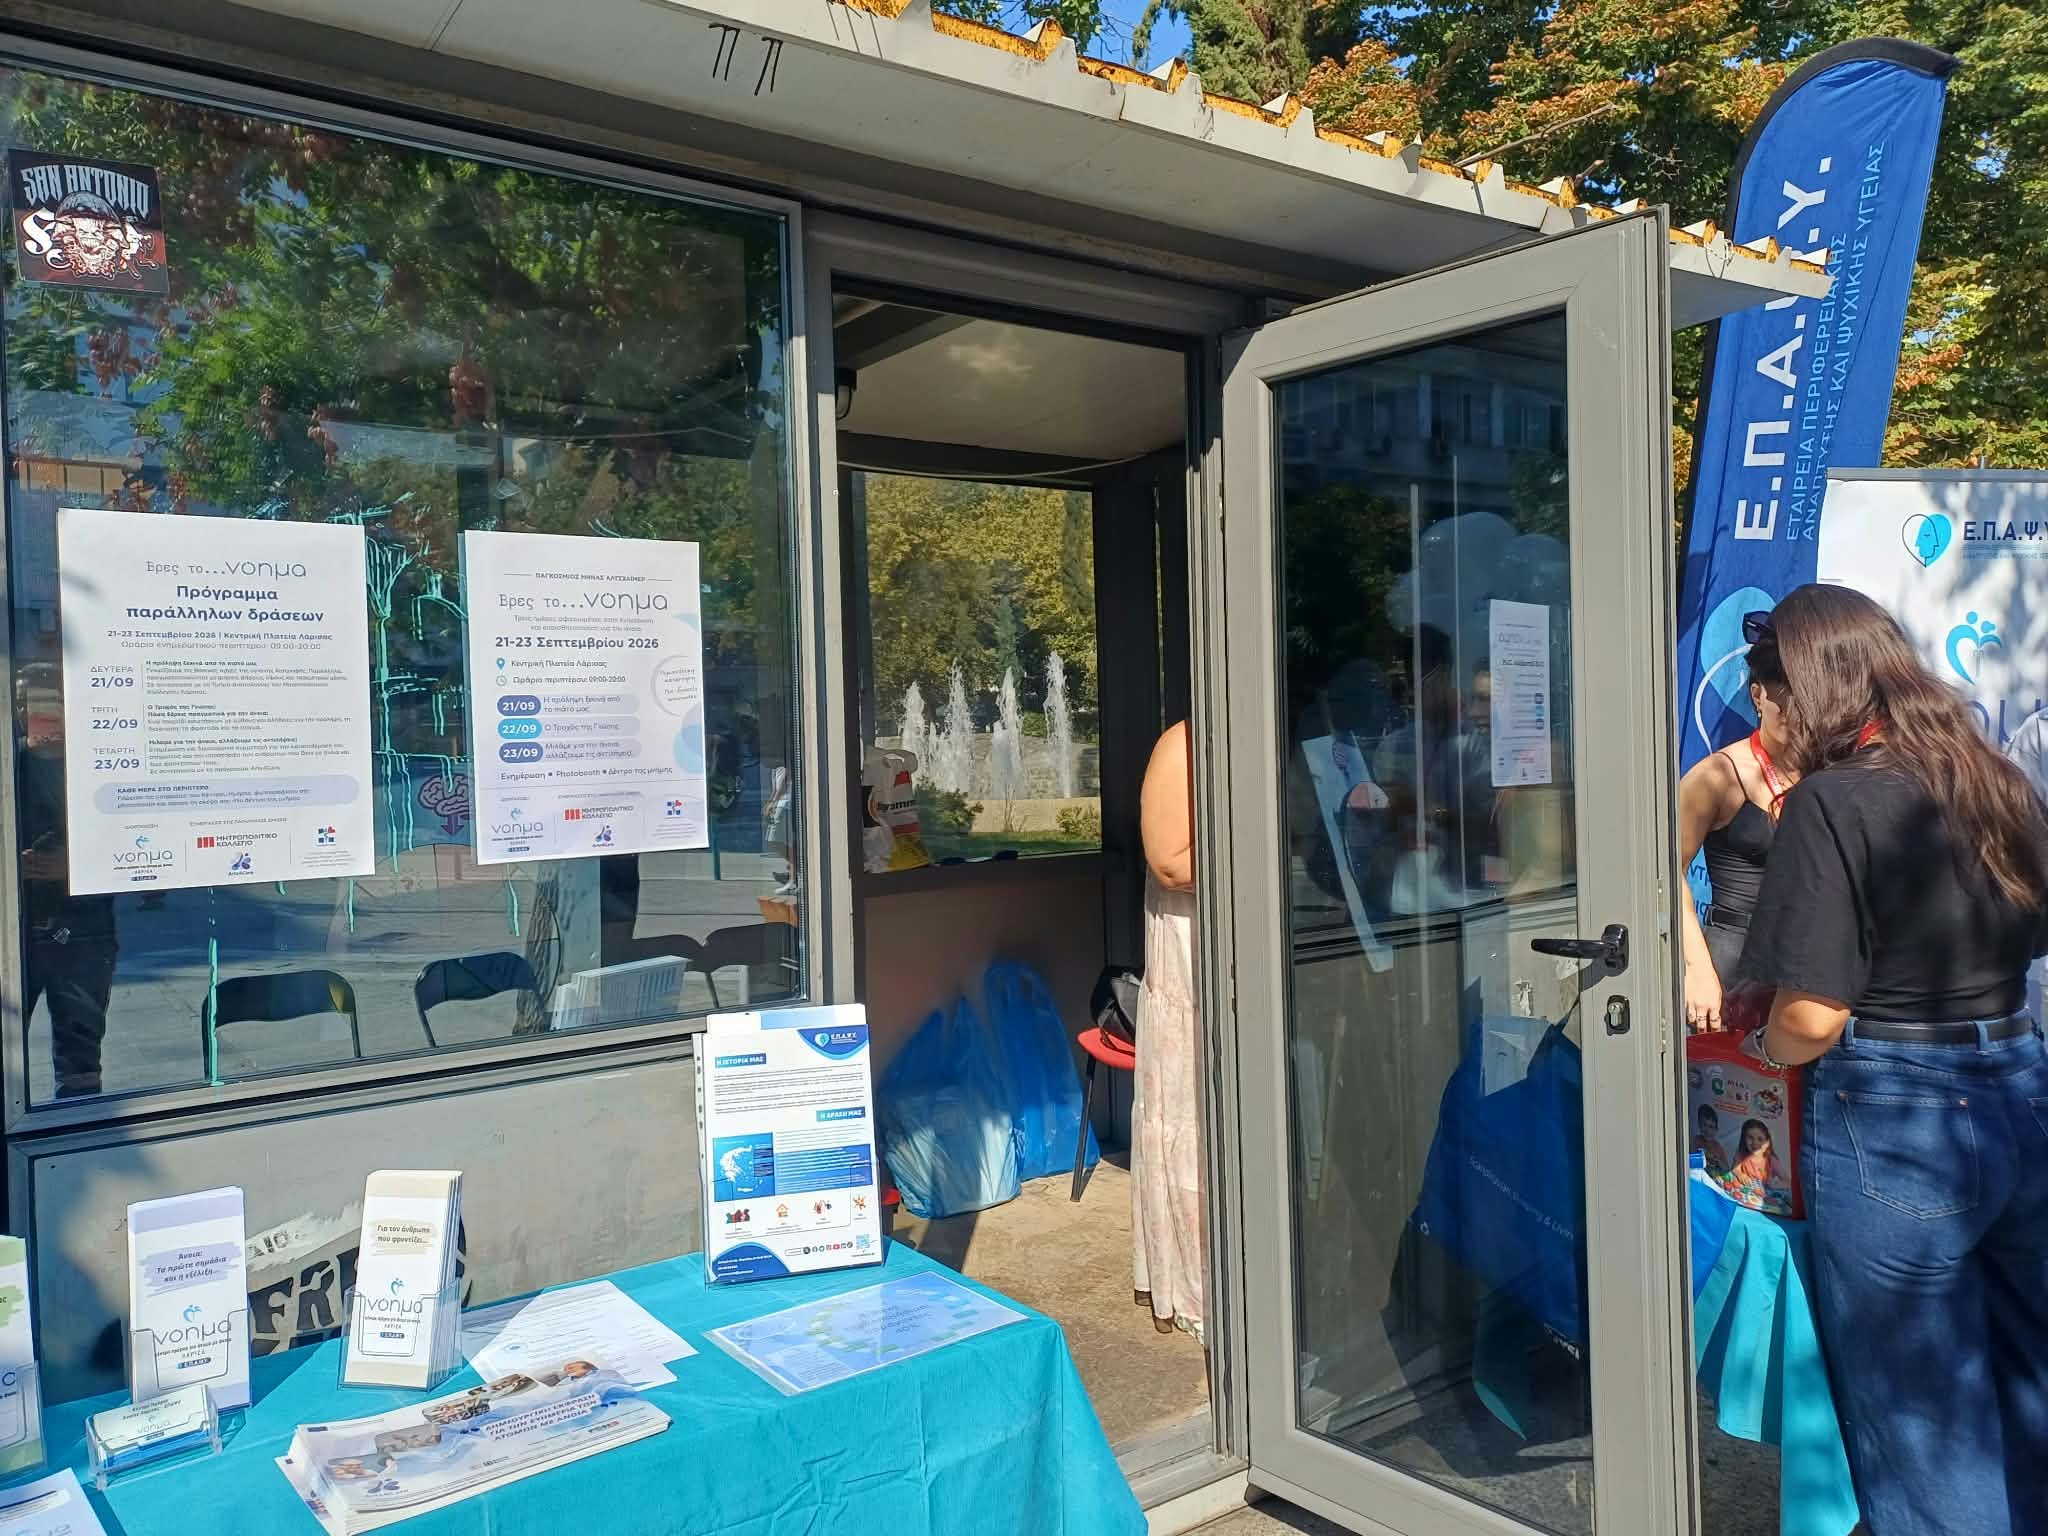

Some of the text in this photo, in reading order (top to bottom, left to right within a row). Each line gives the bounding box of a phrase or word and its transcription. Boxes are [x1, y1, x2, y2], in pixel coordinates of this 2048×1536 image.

[20, 165, 150, 220] SAN ANTONIO
[1856, 142, 1884, 231] ΥΓΕΙΑΣ
[1837, 235, 1868, 344] ΨΥΧΙΚΗΣ
[1734, 156, 1832, 543] Ε.Π.Α..Υ.
[1830, 352, 1850, 391] ΚΑΙ
[1786, 437, 1815, 540] ΕΤΑΙΡΕΙΑ
[177, 585, 278, 602] Πρόγραμμα
[498, 593, 535, 610] Βρες
[126, 606, 324, 623] παράλληλων δράσεων
[135, 630, 193, 640] Σεπτεμβρίου
[224, 632, 262, 641] Κεντρική
[263, 632, 297, 640] Πλατεία
[496, 636, 659, 650] 21-23 Σεπτεμβρίου 2026
[90, 665, 134, 674] ΔΕΥΤΕΡΑ
[511, 659, 608, 669] Κεντρική Πλατεία Λάρισας
[90, 677, 135, 689] 21/09
[513, 675, 543, 685] Ωράριο
[502, 701, 535, 712] 21/09
[92, 719, 139, 730] 22/09
[502, 724, 537, 735] 22/09
[94, 748, 136, 756] ΤΕΤΑΡΤΗ
[503, 748, 538, 760] 23/09
[94, 759, 140, 771] 23/09
[501, 771, 546, 781] Ενημέρωση
[556, 768, 601, 777] Photobooth
[723, 1057, 749, 1065] ΙΣΤΟΡΙΑ
